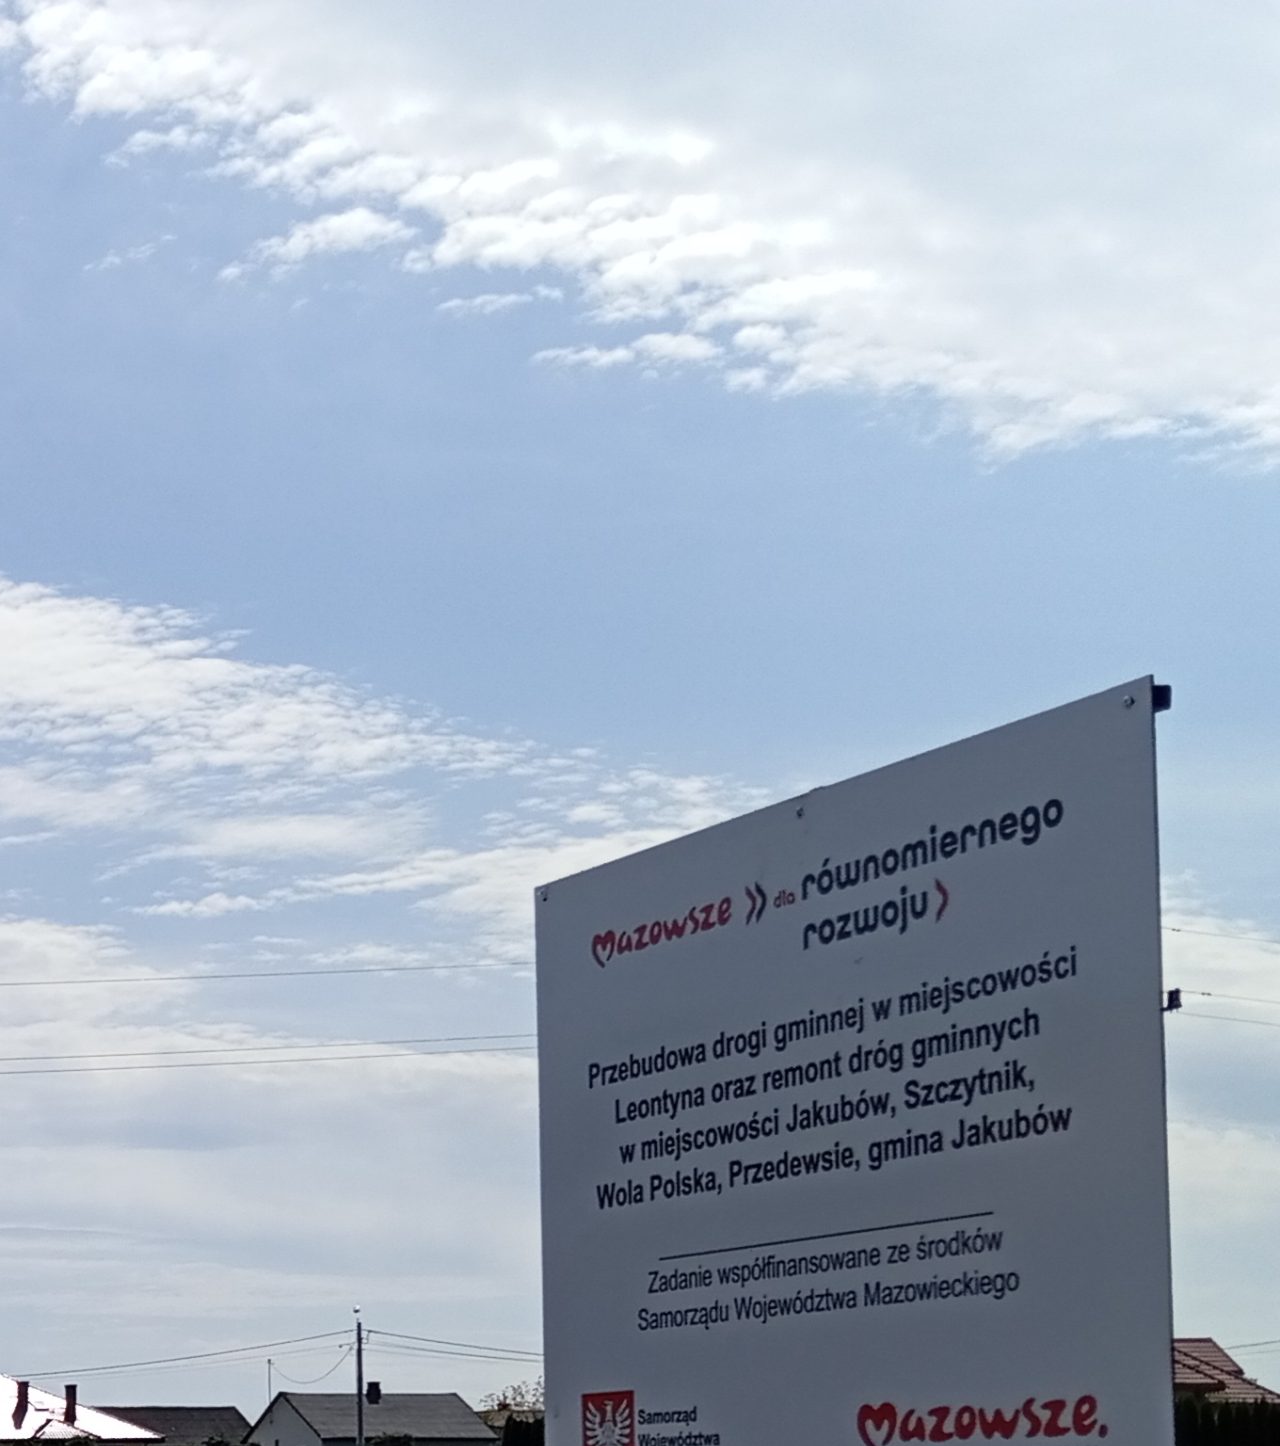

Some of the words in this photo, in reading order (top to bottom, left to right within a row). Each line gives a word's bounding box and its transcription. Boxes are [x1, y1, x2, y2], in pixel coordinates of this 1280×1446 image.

[801, 799, 1064, 900] równomiernego
[592, 896, 732, 968] Mazowsze
[803, 885, 928, 950] rozwoju
[588, 1046, 706, 1089] Przebudowa
[712, 1021, 766, 1058] drogi
[773, 998, 864, 1051] gminnej
[872, 998, 892, 1022] w
[899, 945, 1077, 1016] miejscowości
[615, 1087, 705, 1124] Leontyna
[711, 1075, 757, 1103] oraz
[762, 1051, 842, 1093] remont
[848, 1039, 903, 1073] dróg
[912, 1007, 1040, 1068] gminnych
[619, 1143, 636, 1165] w
[641, 1108, 779, 1161] miejscowości
[786, 1089, 896, 1132] Jakubów,
[904, 1059, 1034, 1110] Szczytnik,
[596, 1179, 644, 1210] Wola
[650, 1167, 722, 1201] Polska,
[729, 1141, 860, 1188] Przedewsie,
[868, 1129, 943, 1171] gmina
[951, 1104, 1072, 1149] Jakubów
[637, 1300, 729, 1331] Samorządu
[734, 1287, 857, 1324] Województwa
[864, 1270, 1020, 1307] Mazowieckiego
[648, 1265, 712, 1294] Zadanie
[717, 1247, 881, 1288] współfinansowane
[887, 1243, 910, 1264] ze
[916, 1227, 1003, 1261] środków
[638, 1405, 697, 1427] Samorząd
